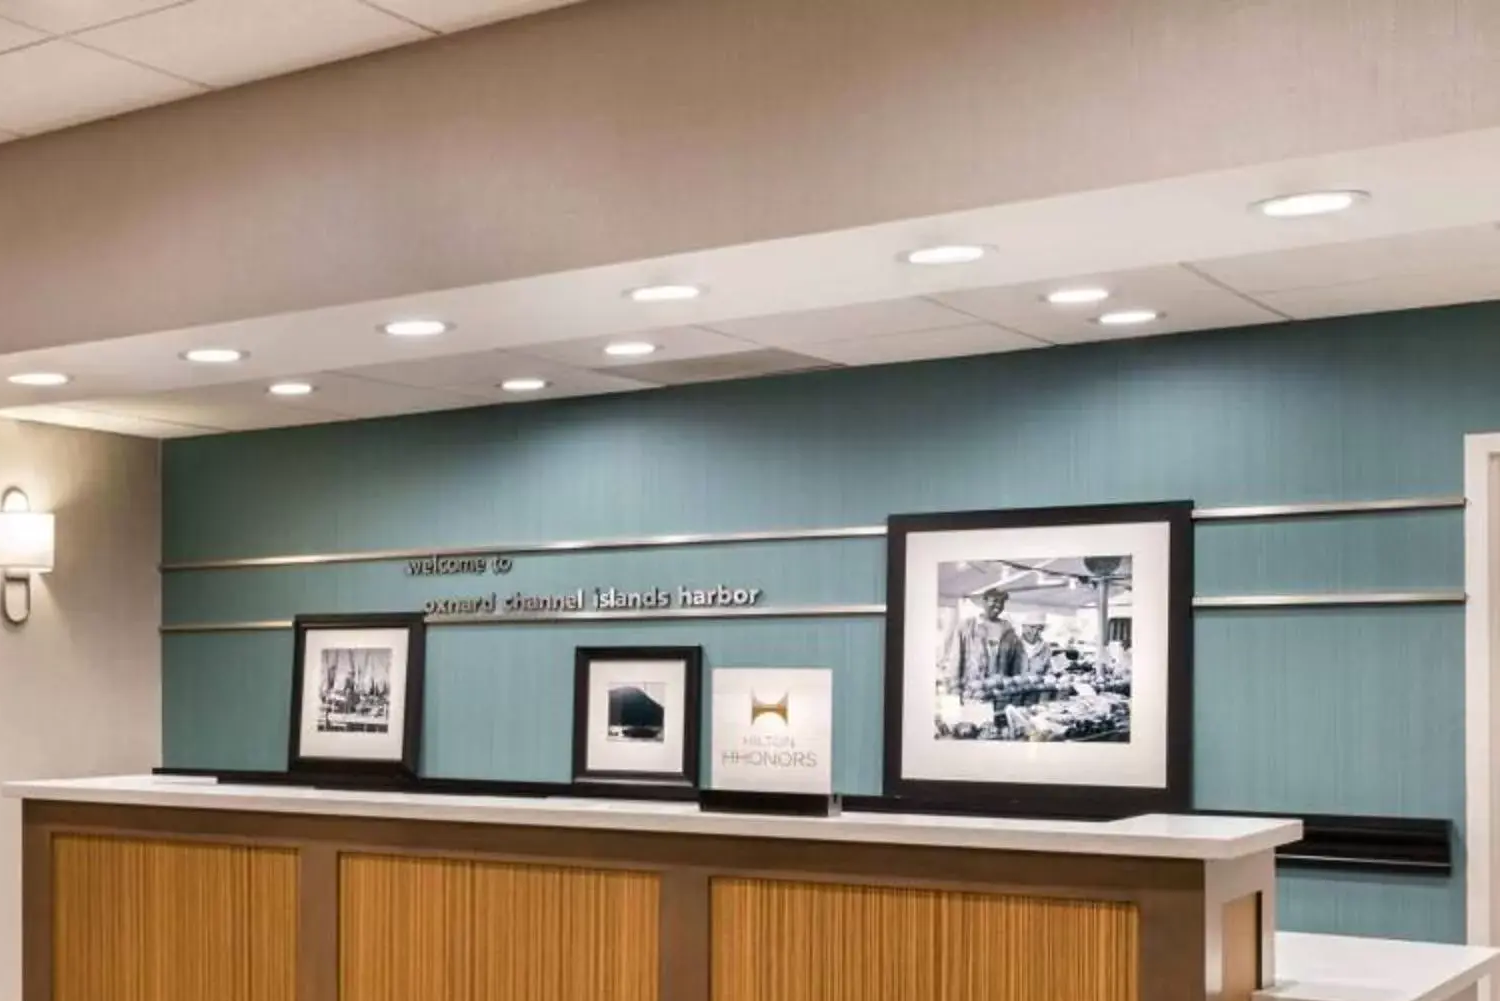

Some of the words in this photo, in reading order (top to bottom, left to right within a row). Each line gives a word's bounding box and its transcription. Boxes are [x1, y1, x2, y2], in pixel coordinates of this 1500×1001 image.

[407, 555, 486, 576] welcome
[492, 554, 513, 574] to
[424, 592, 496, 615] oxnard
[504, 588, 585, 612] channel
[593, 586, 671, 610] islands
[677, 583, 762, 607] harbor
